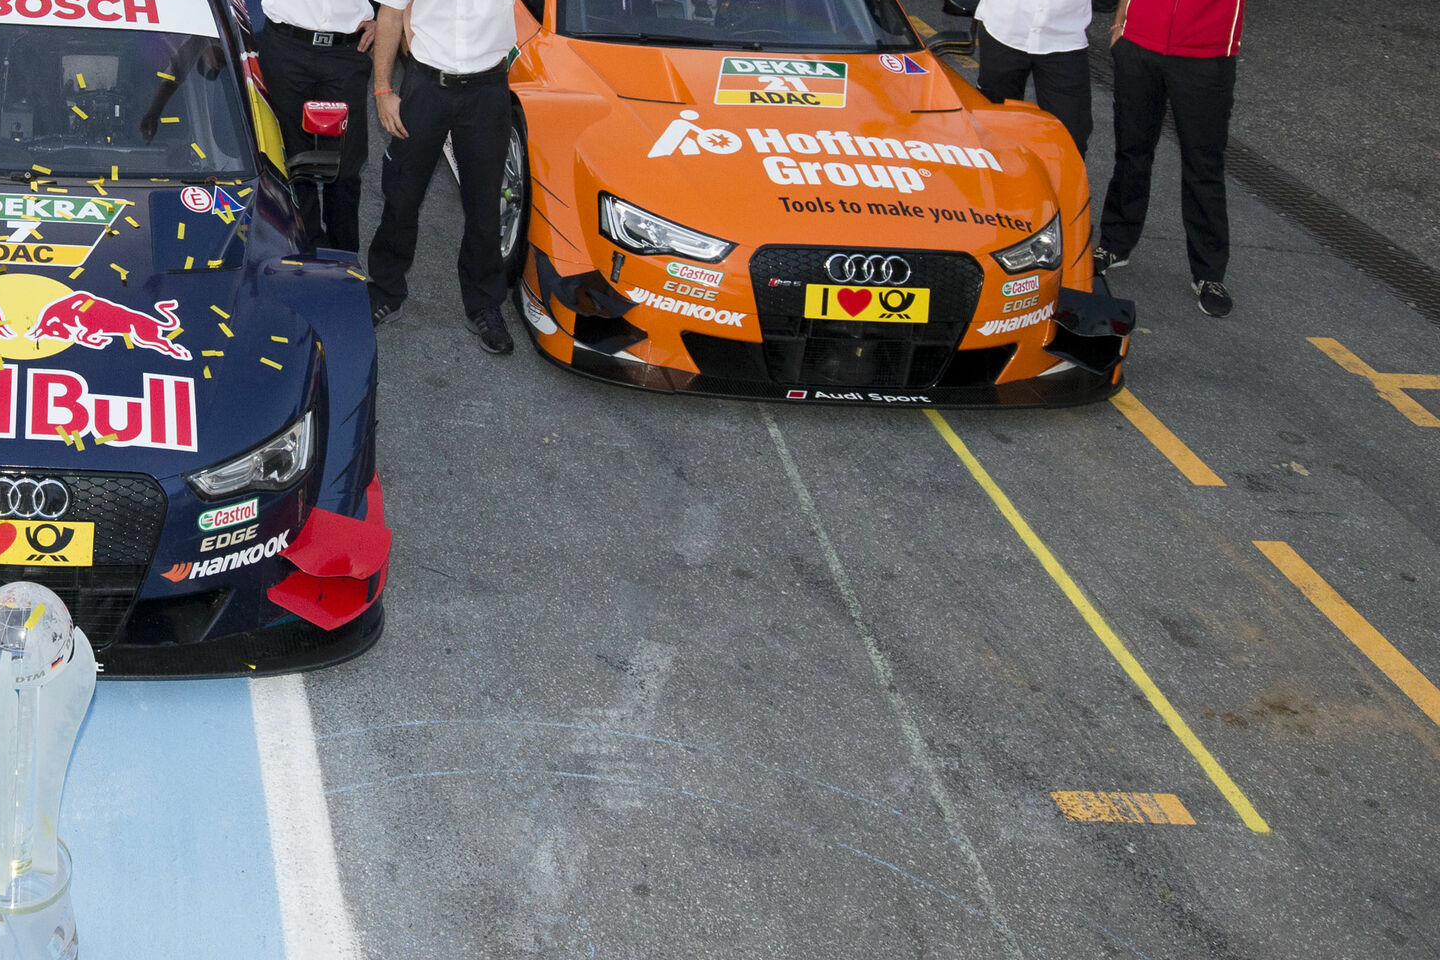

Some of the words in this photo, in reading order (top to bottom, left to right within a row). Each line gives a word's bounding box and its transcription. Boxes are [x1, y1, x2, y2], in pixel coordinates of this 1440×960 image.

[730, 58, 841, 78] DEKRA
[758, 76, 809, 92] 21
[749, 90, 821, 105] ADAC
[746, 127, 1004, 173] Hoffmann
[779, 196, 835, 215] Tools
[839, 197, 862, 215] to
[868, 199, 924, 220] make
[932, 208, 965, 226] you
[969, 207, 1034, 234] better
[6, 221, 42, 243] 7
[678, 265, 721, 285] Castrol
[662, 281, 720, 302] EDGE
[1012, 277, 1039, 296] Castrol
[1002, 295, 1039, 314] EDGE
[814, 390, 865, 402] Audi
[868, 391, 932, 404] Sport
[31, 370, 195, 448] Bull
[214, 502, 256, 526] Castrol
[200, 523, 260, 552] EDGE
[15, 669, 46, 684] DTM
